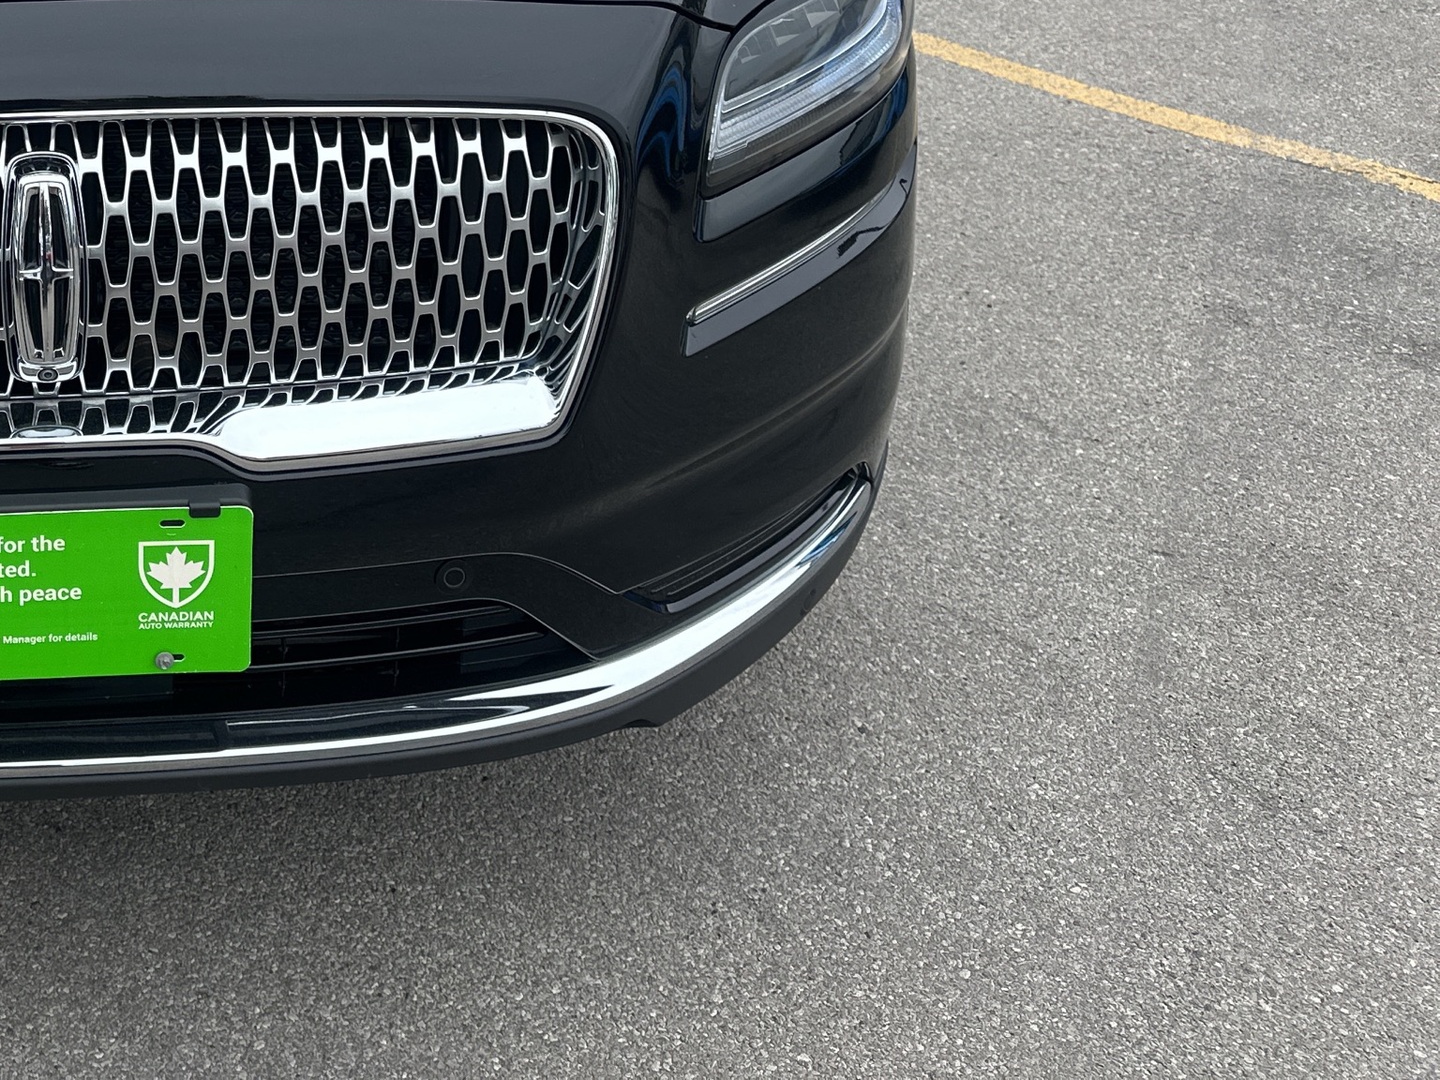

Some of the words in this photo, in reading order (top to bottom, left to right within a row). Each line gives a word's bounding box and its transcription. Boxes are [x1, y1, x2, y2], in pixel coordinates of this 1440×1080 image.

[31, 534, 66, 553] the
[19, 587, 82, 607] peace
[138, 611, 214, 622] CANADIAN
[138, 622, 162, 630] AUTO
[163, 621, 214, 629] WARRANTY
[2, 634, 46, 645] Manager
[48, 633, 63, 642] for
[64, 632, 98, 642] details
